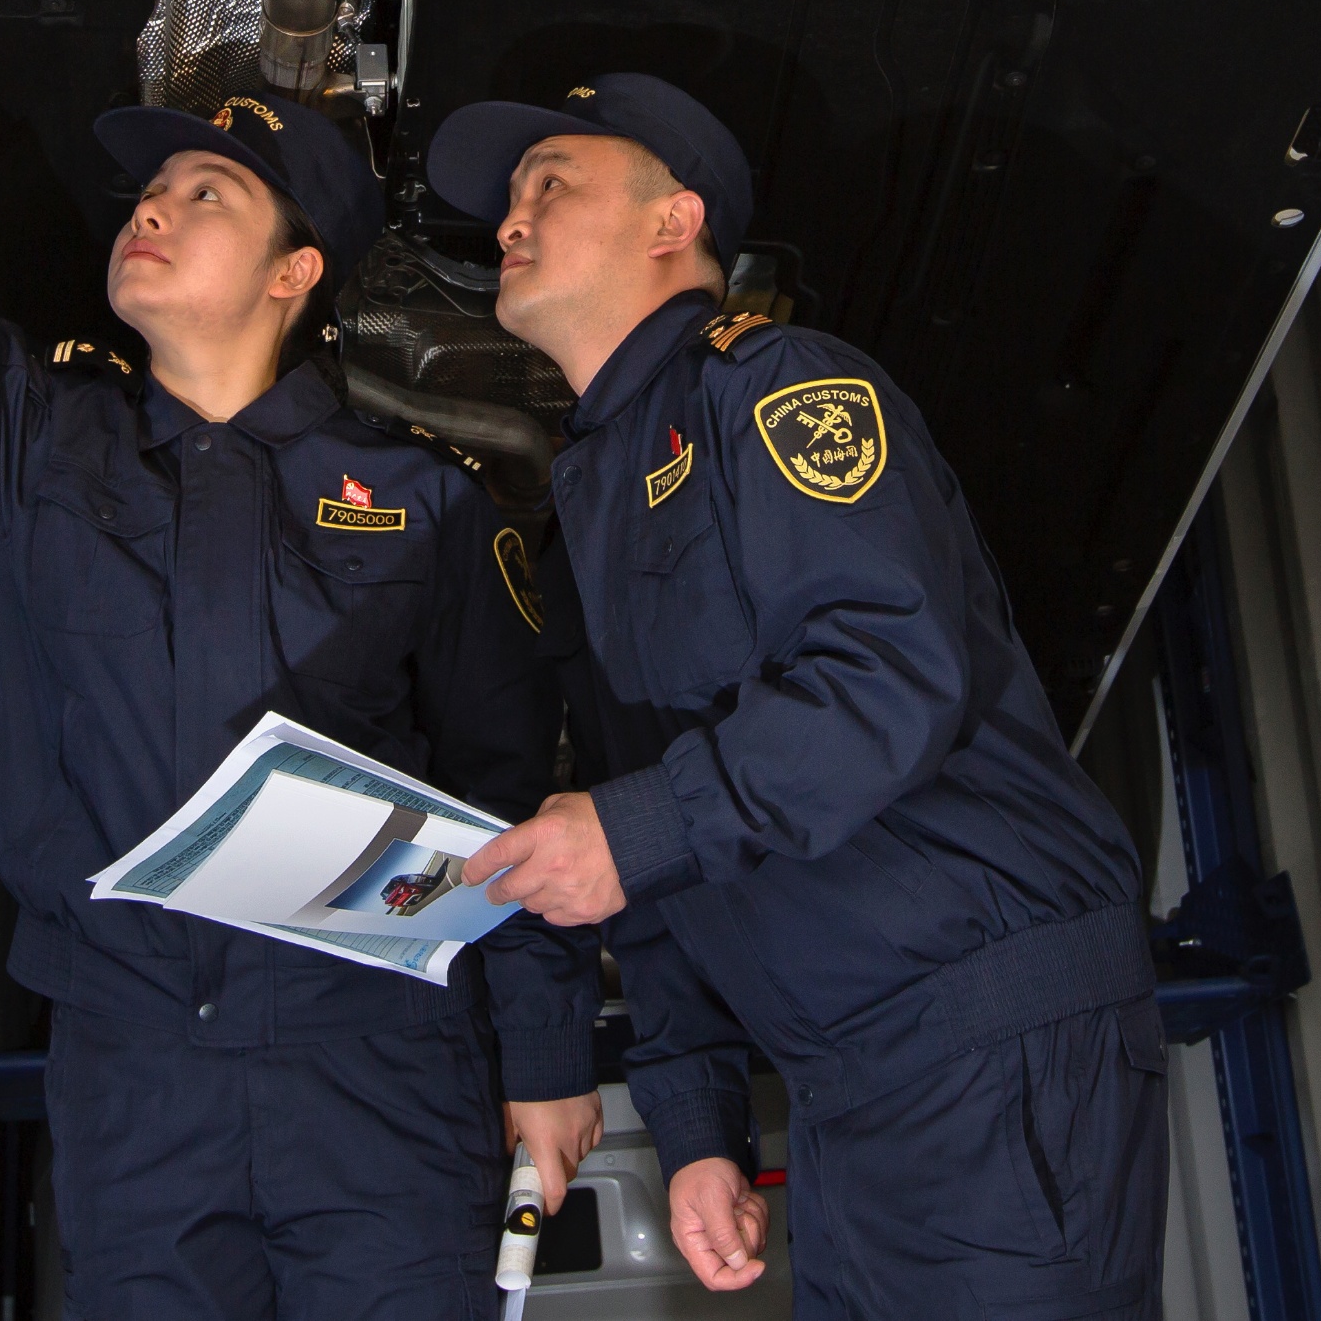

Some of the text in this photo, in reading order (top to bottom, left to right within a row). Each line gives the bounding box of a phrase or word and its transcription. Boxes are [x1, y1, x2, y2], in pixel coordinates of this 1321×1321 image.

[224, 96, 284, 131] CUSTOMS
[766, 389, 870, 429] CHINA CUSTOMS
[327, 507, 395, 525] 7905000
